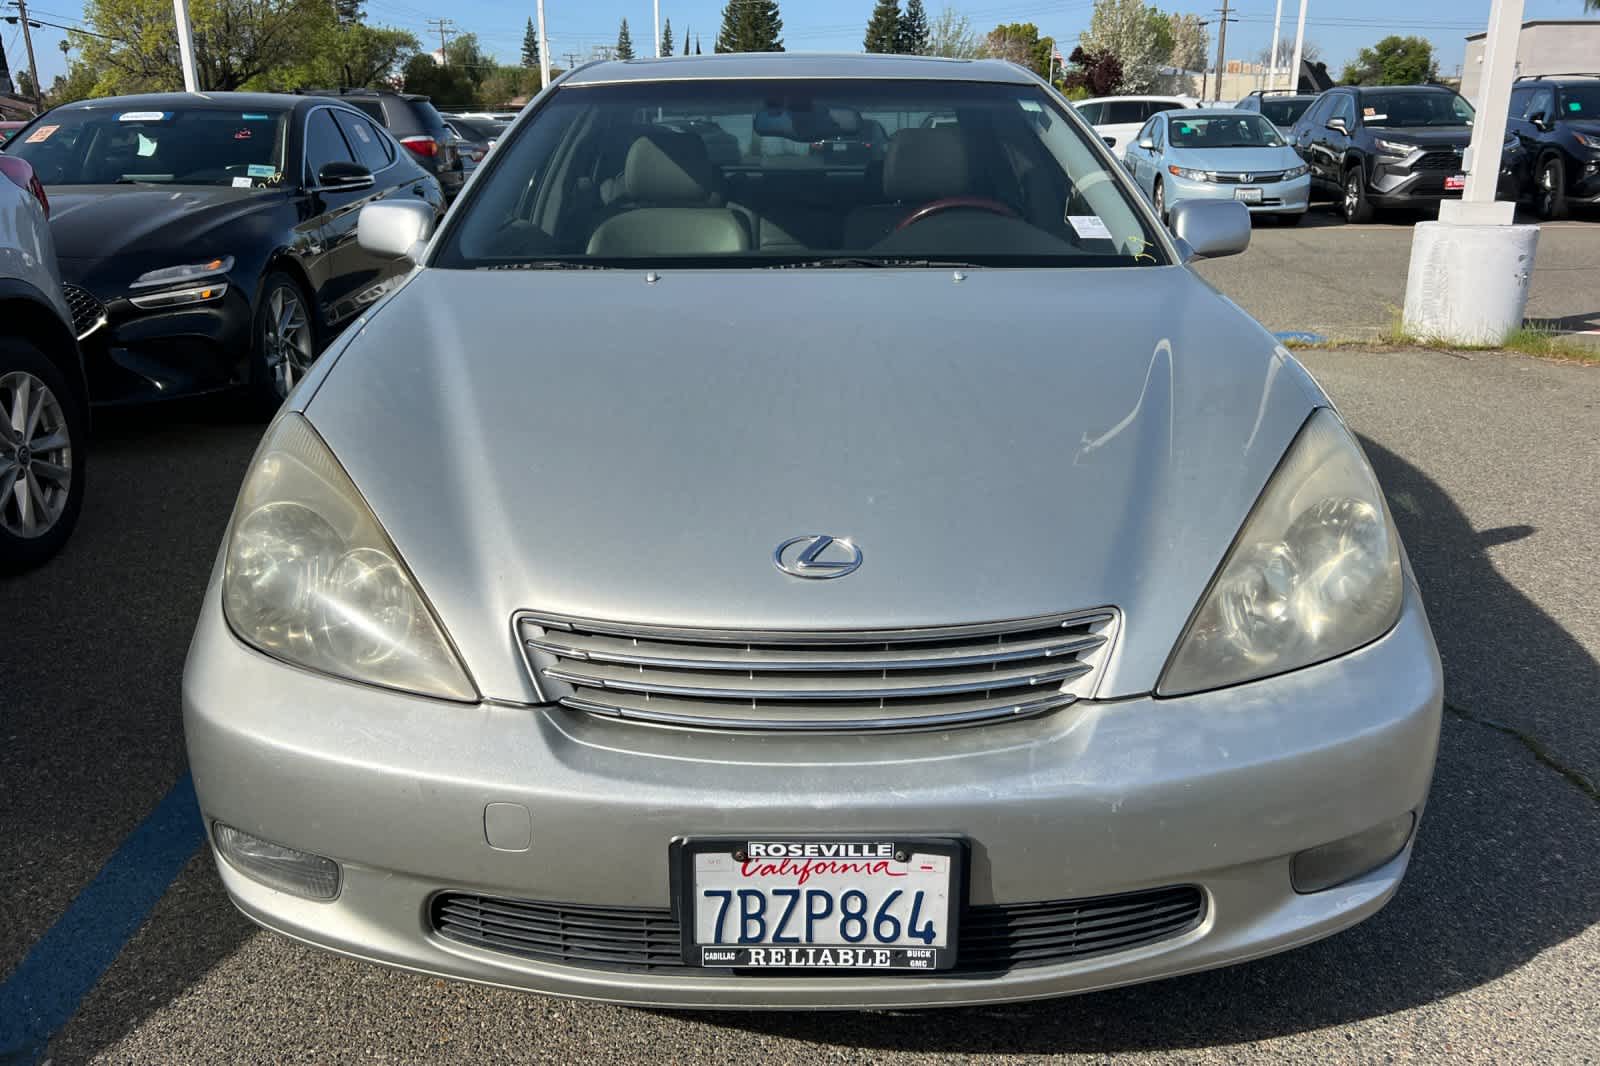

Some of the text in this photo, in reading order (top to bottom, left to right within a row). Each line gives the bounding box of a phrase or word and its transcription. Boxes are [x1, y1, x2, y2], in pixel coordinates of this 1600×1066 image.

[750, 844, 893, 857] ROSEVILLE
[740, 858, 908, 885] California
[703, 889, 937, 944] 7BZP864
[704, 951, 736, 961] CADILLAC
[748, 949, 891, 966] RELIABLE
[906, 950, 932, 958] BUICK
[910, 959, 928, 967] GMC
